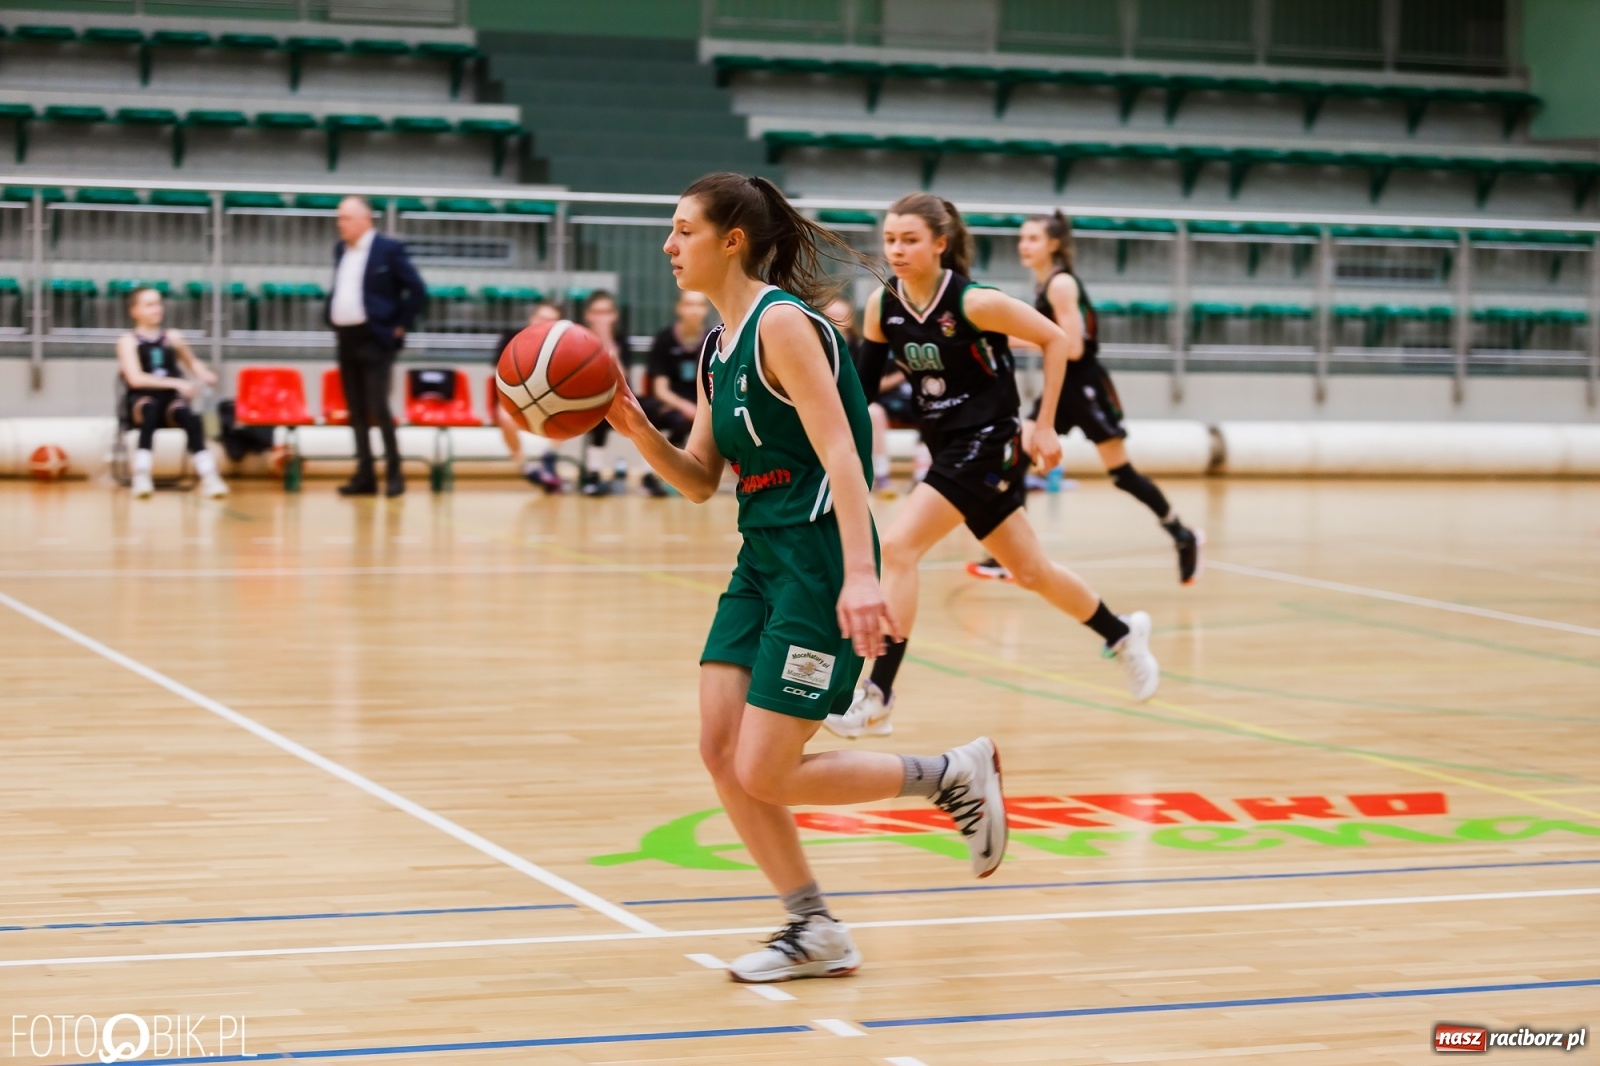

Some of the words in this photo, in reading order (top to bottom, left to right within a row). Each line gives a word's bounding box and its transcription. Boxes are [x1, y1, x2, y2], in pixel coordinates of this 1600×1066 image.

[904, 342, 945, 371] 99
[734, 406, 763, 447] 7
[782, 686, 821, 700] COLO
